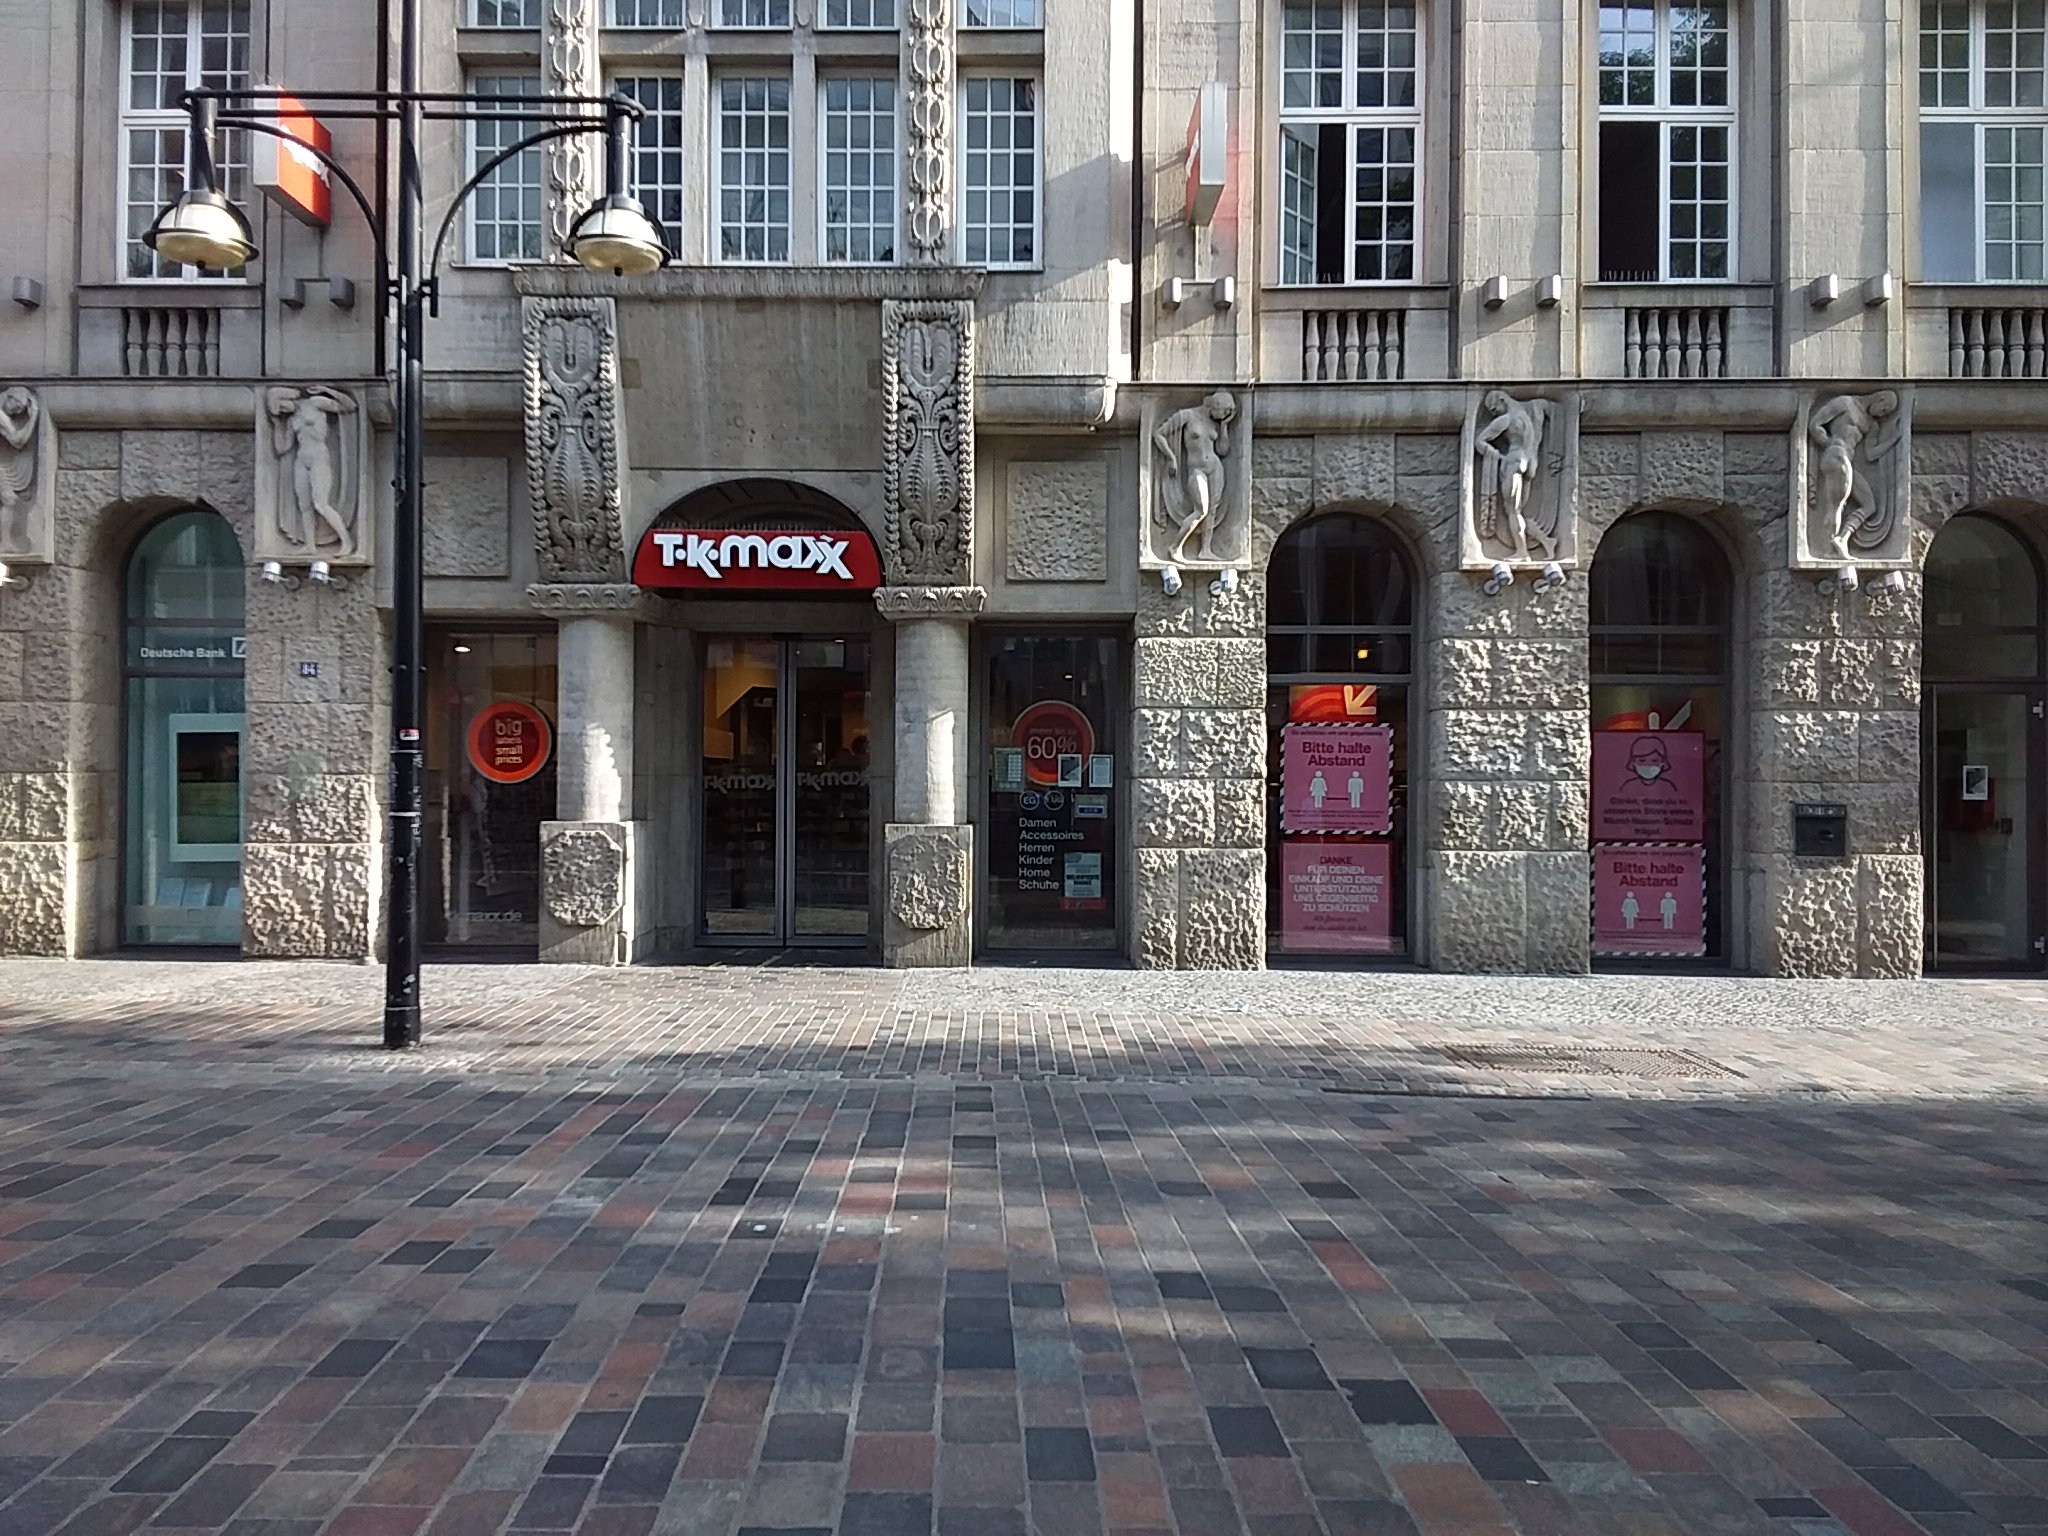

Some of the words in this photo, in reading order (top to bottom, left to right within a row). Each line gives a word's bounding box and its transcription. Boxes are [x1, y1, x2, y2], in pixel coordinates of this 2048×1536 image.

[140, 647, 195, 658] Deutsche
[196, 647, 226, 658] Bank
[495, 719, 522, 736] big
[495, 745, 523, 755] small
[1027, 735, 1077, 759] 60%
[1302, 741, 1334, 754] Bitte
[1338, 742, 1372, 754] halte
[1308, 754, 1365, 767] Abstand
[1022, 796, 1037, 805] EG
[1018, 817, 1057, 828] Damen
[1019, 830, 1085, 840] Accessoires
[1018, 842, 1055, 852] Herren
[1018, 855, 1054, 865] Kinder
[1319, 856, 1353, 865] DANKE
[1018, 867, 1051, 877] Home
[1307, 865, 1327, 874] FÜR
[1329, 866, 1365, 874] DEINEN
[1613, 862, 1647, 874] Bitte
[1650, 862, 1684, 874] halte
[1288, 874, 1331, 883] EINKAUF
[1331, 875, 1353, 884] UND
[1355, 876, 1384, 884] DEINE
[1618, 875, 1679, 887] Abstand
[1018, 879, 1060, 890] Schuhe
[1293, 894, 1314, 902] UNS
[1302, 903, 1316, 912] ZU
